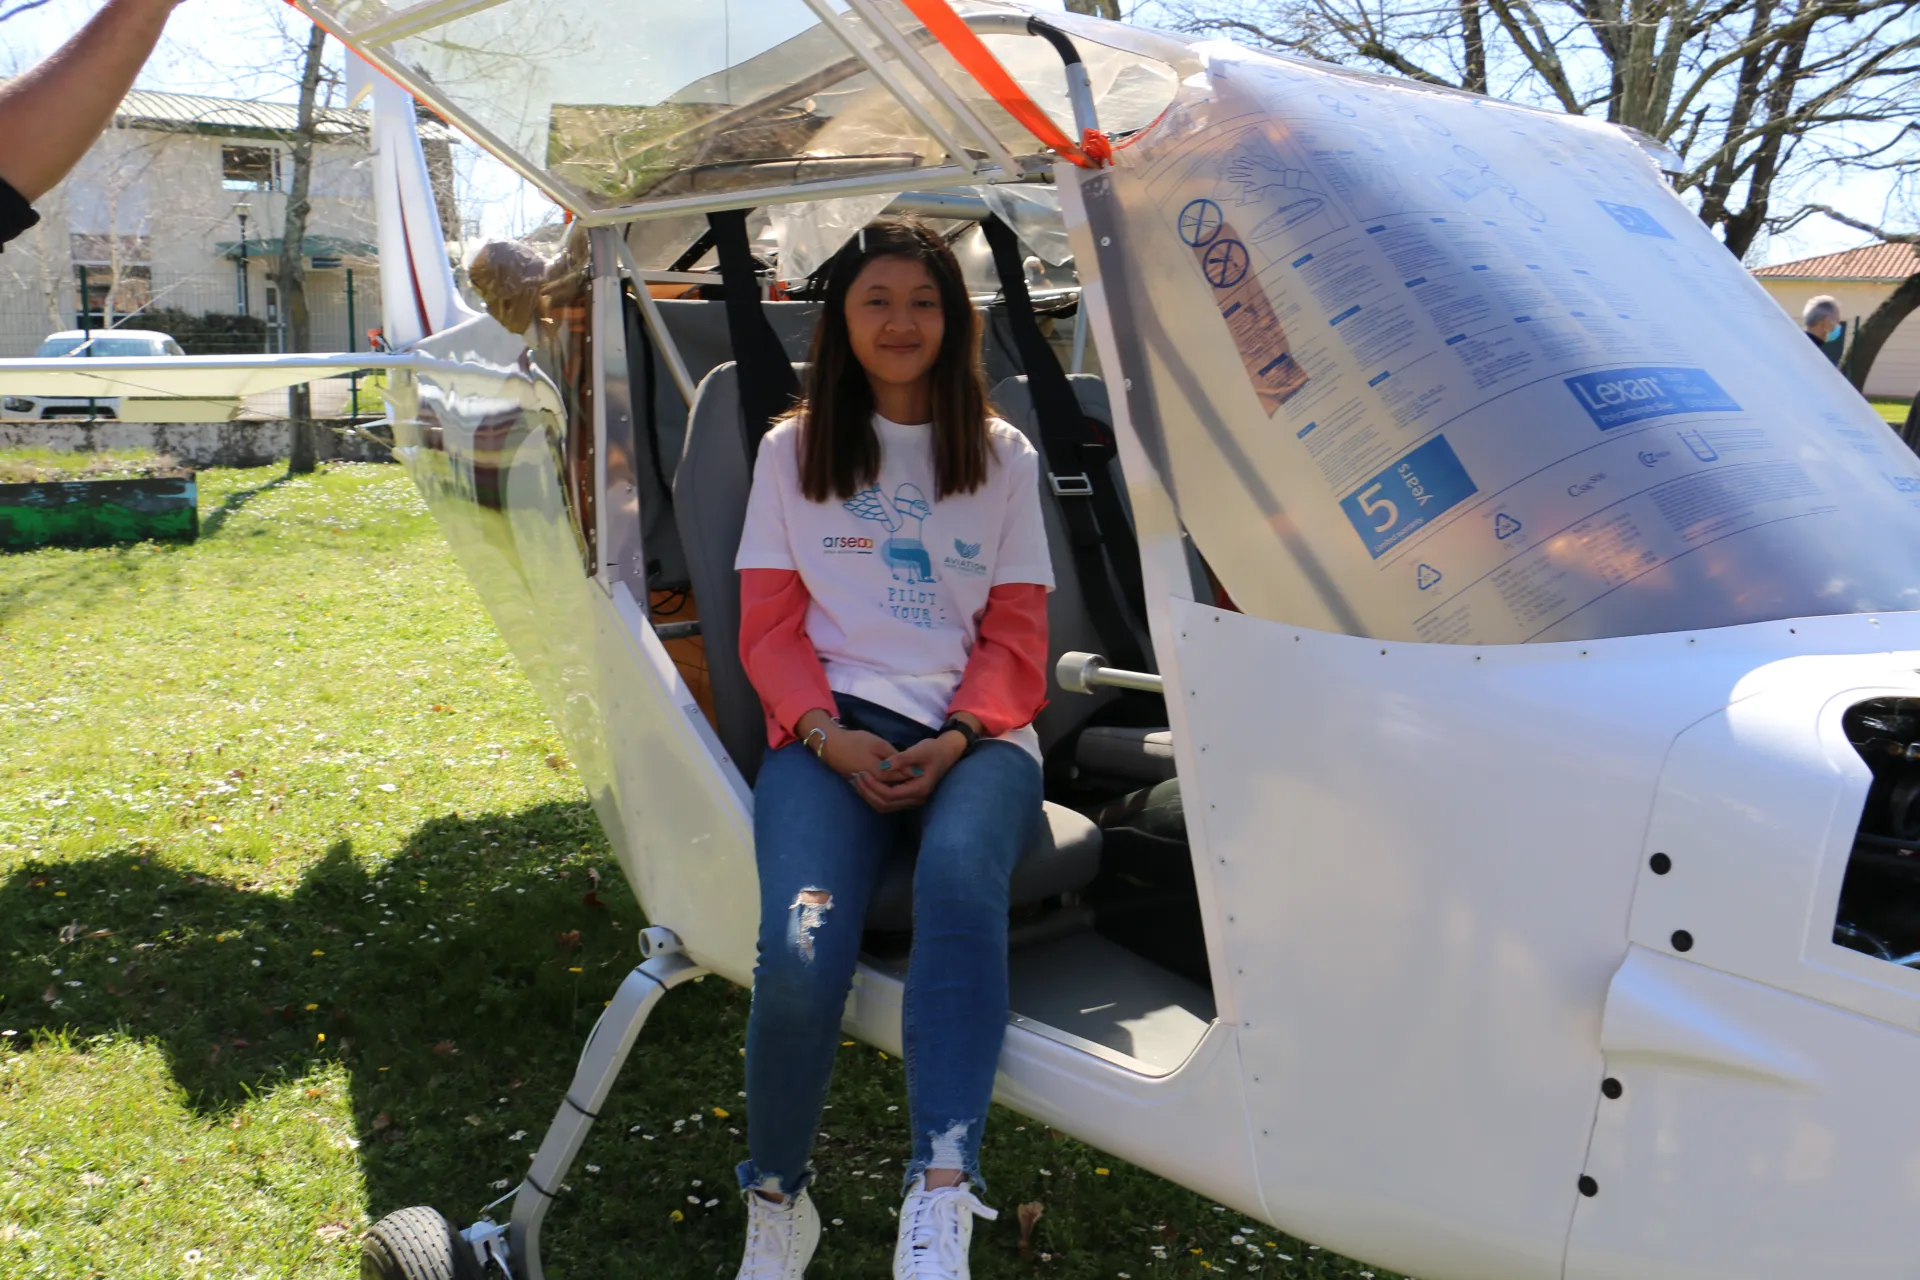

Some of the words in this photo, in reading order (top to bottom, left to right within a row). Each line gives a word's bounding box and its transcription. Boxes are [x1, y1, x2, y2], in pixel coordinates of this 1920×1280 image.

[1575, 376, 1666, 410] Lexan
[1398, 463, 1434, 506] years
[1357, 482, 1399, 532] 5
[943, 556, 987, 571] AVIATION
[887, 587, 936, 605] PILOT
[889, 605, 932, 621] YOUR
